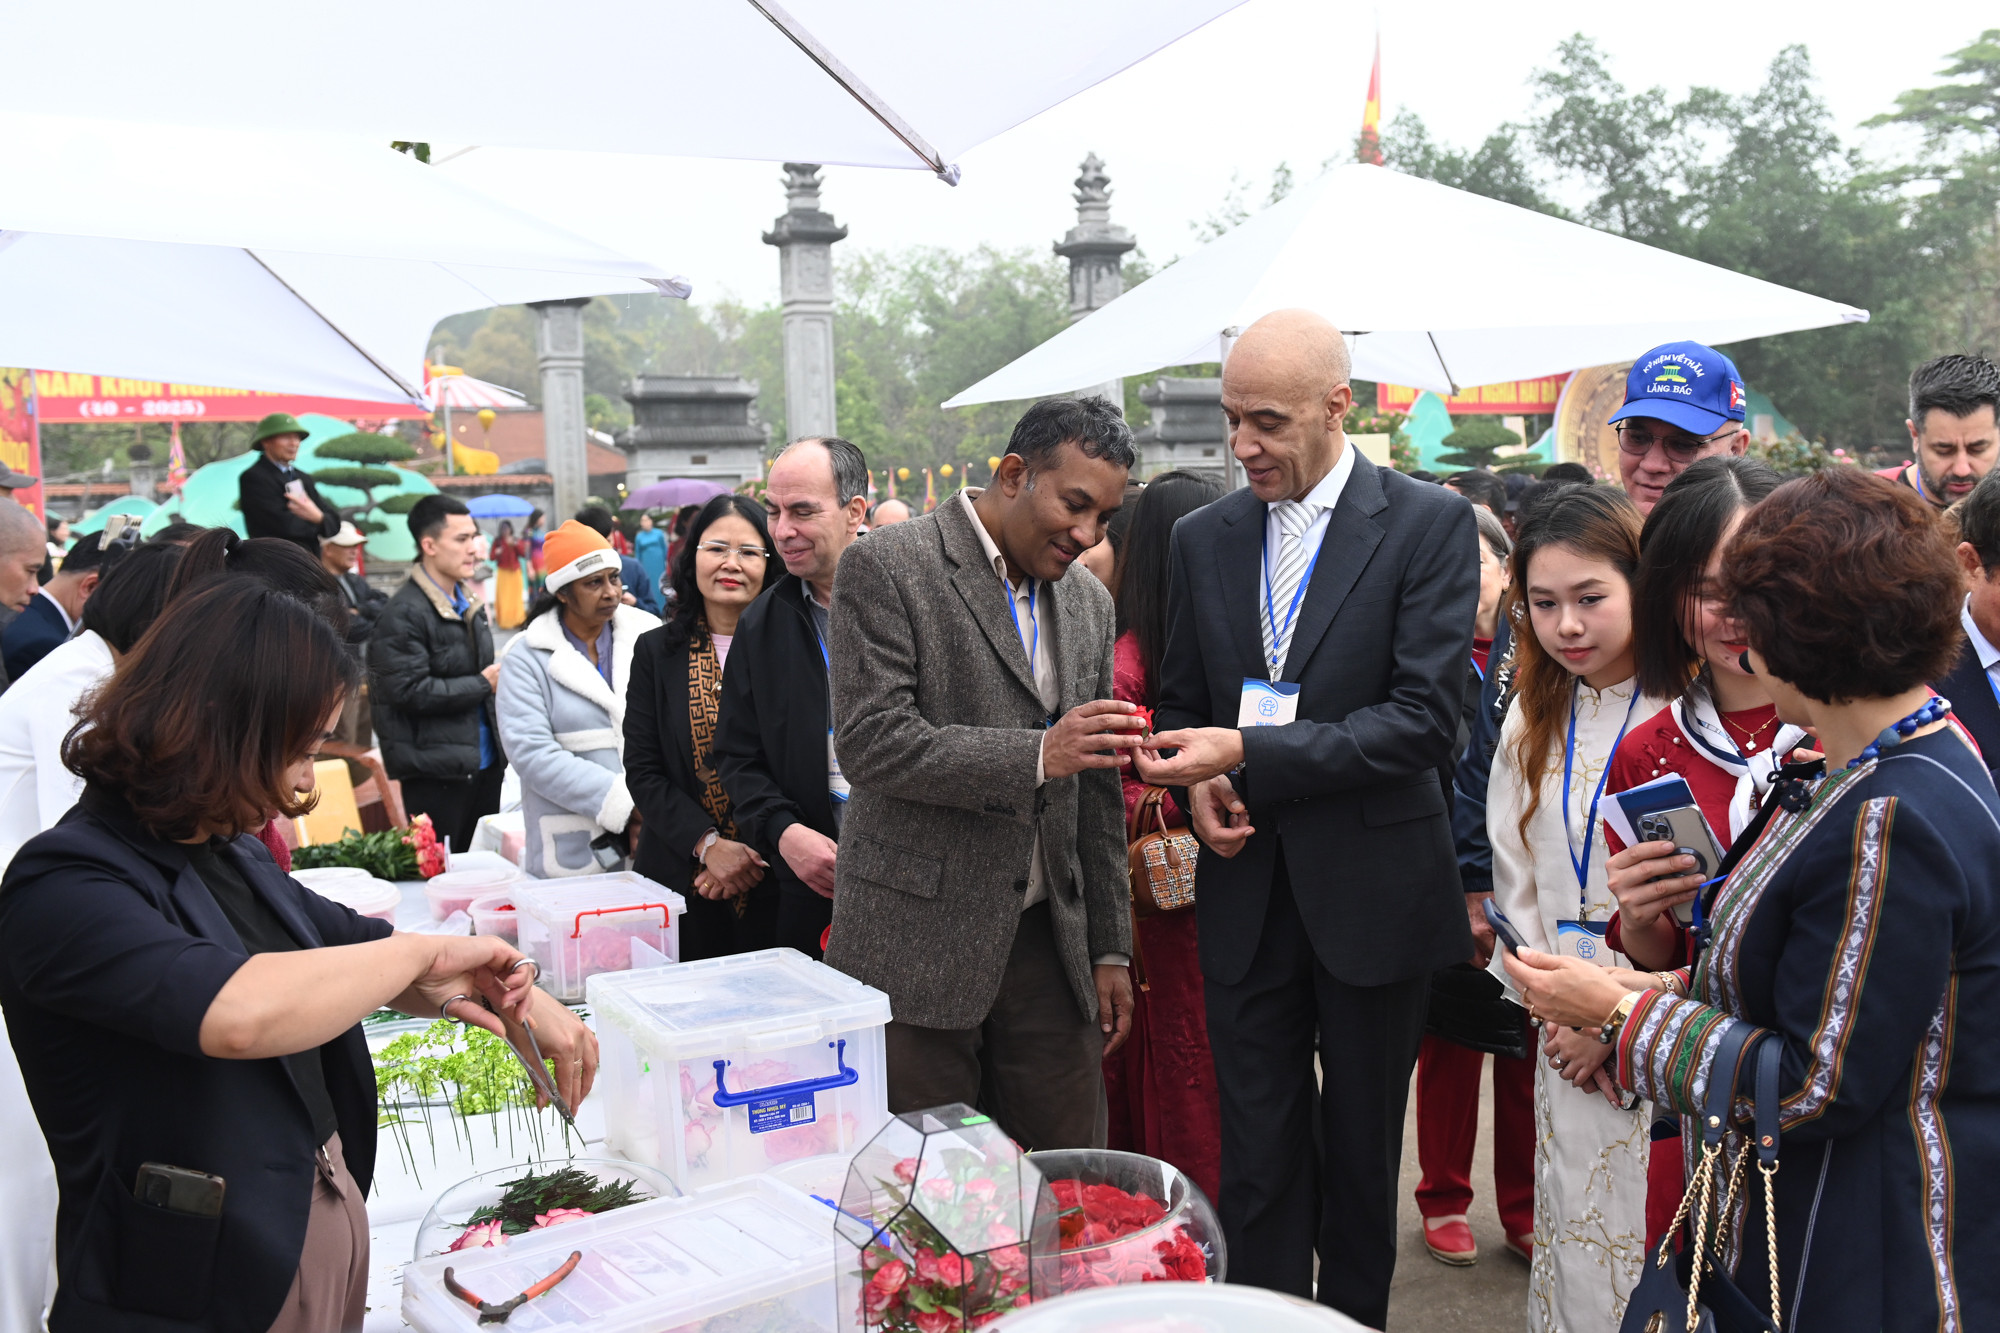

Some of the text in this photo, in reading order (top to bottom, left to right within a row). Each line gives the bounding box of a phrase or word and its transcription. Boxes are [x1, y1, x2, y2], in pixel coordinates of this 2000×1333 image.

[1519, 381, 1540, 403] HAI
[1646, 382, 1693, 396] LĂNG BÁC
